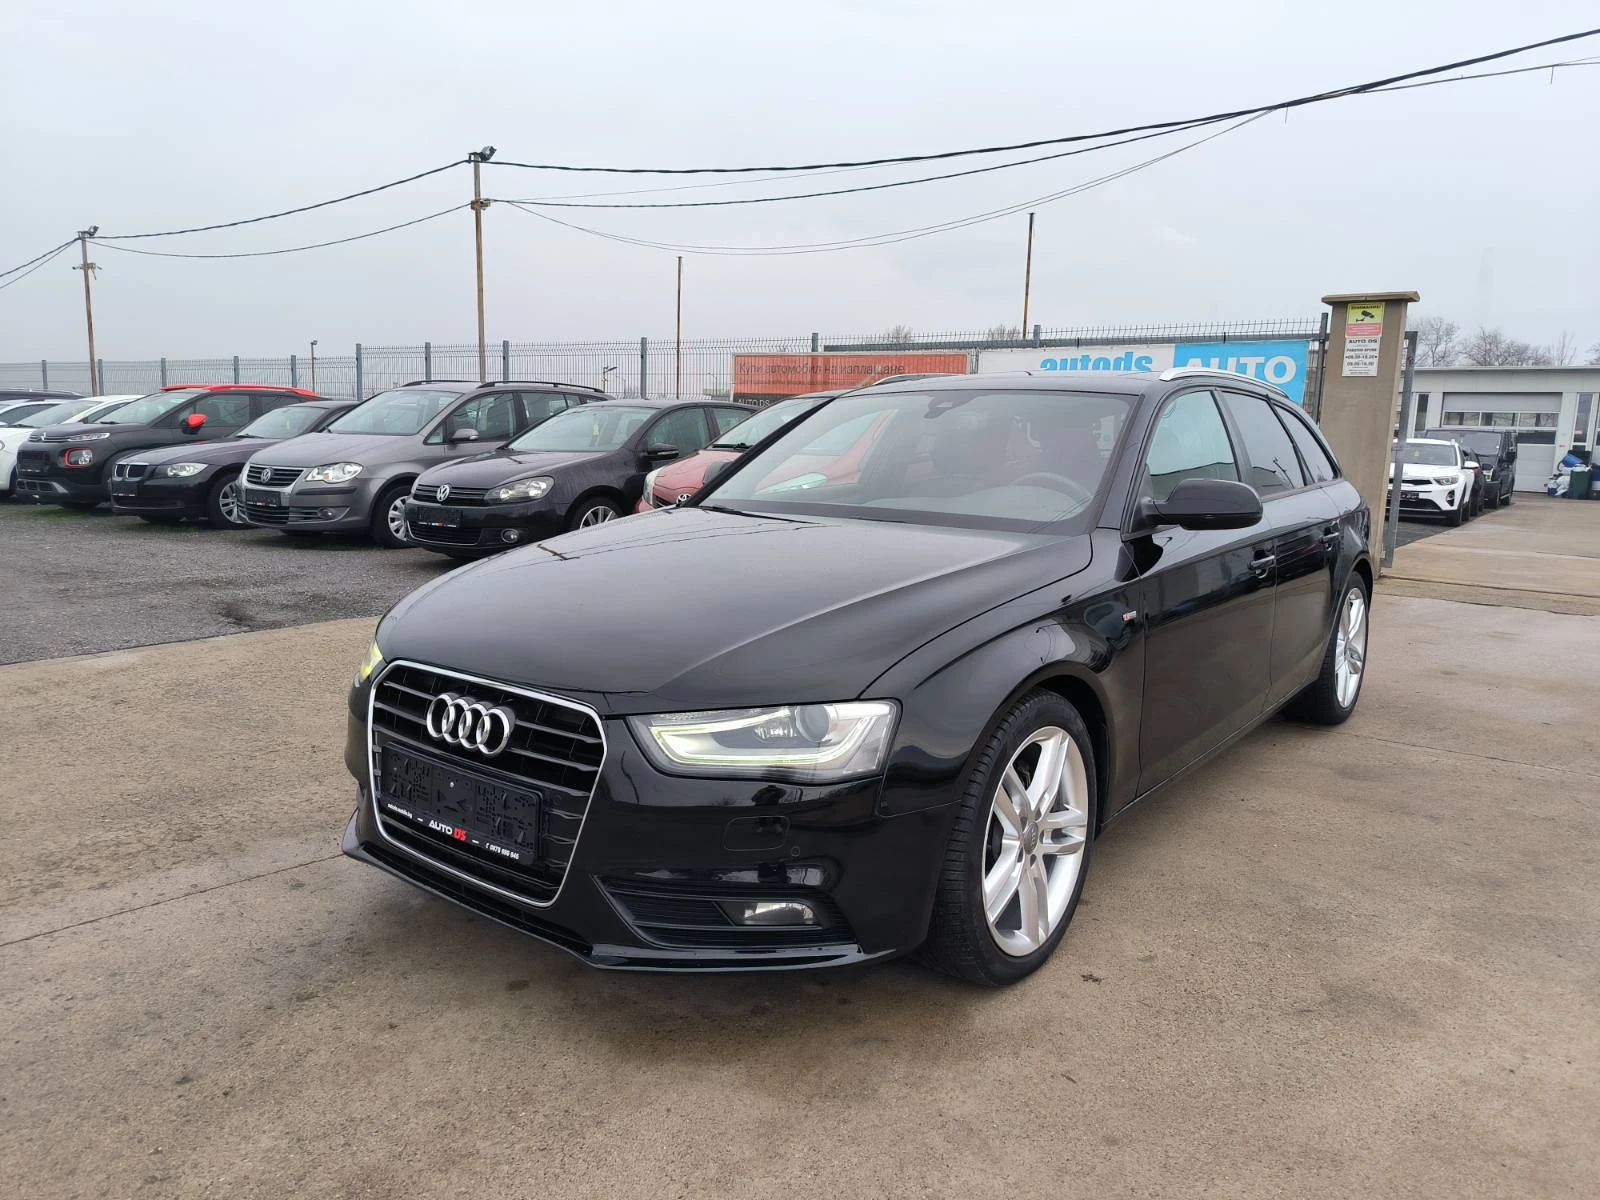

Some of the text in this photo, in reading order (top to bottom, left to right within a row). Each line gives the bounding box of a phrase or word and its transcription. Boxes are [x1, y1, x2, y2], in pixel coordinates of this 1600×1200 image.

[738, 362, 905, 375] Купи автомобил на изплащане
[738, 398, 758, 407] AUTO
[429, 819, 453, 835] AUTO
[453, 827, 467, 841] DS
